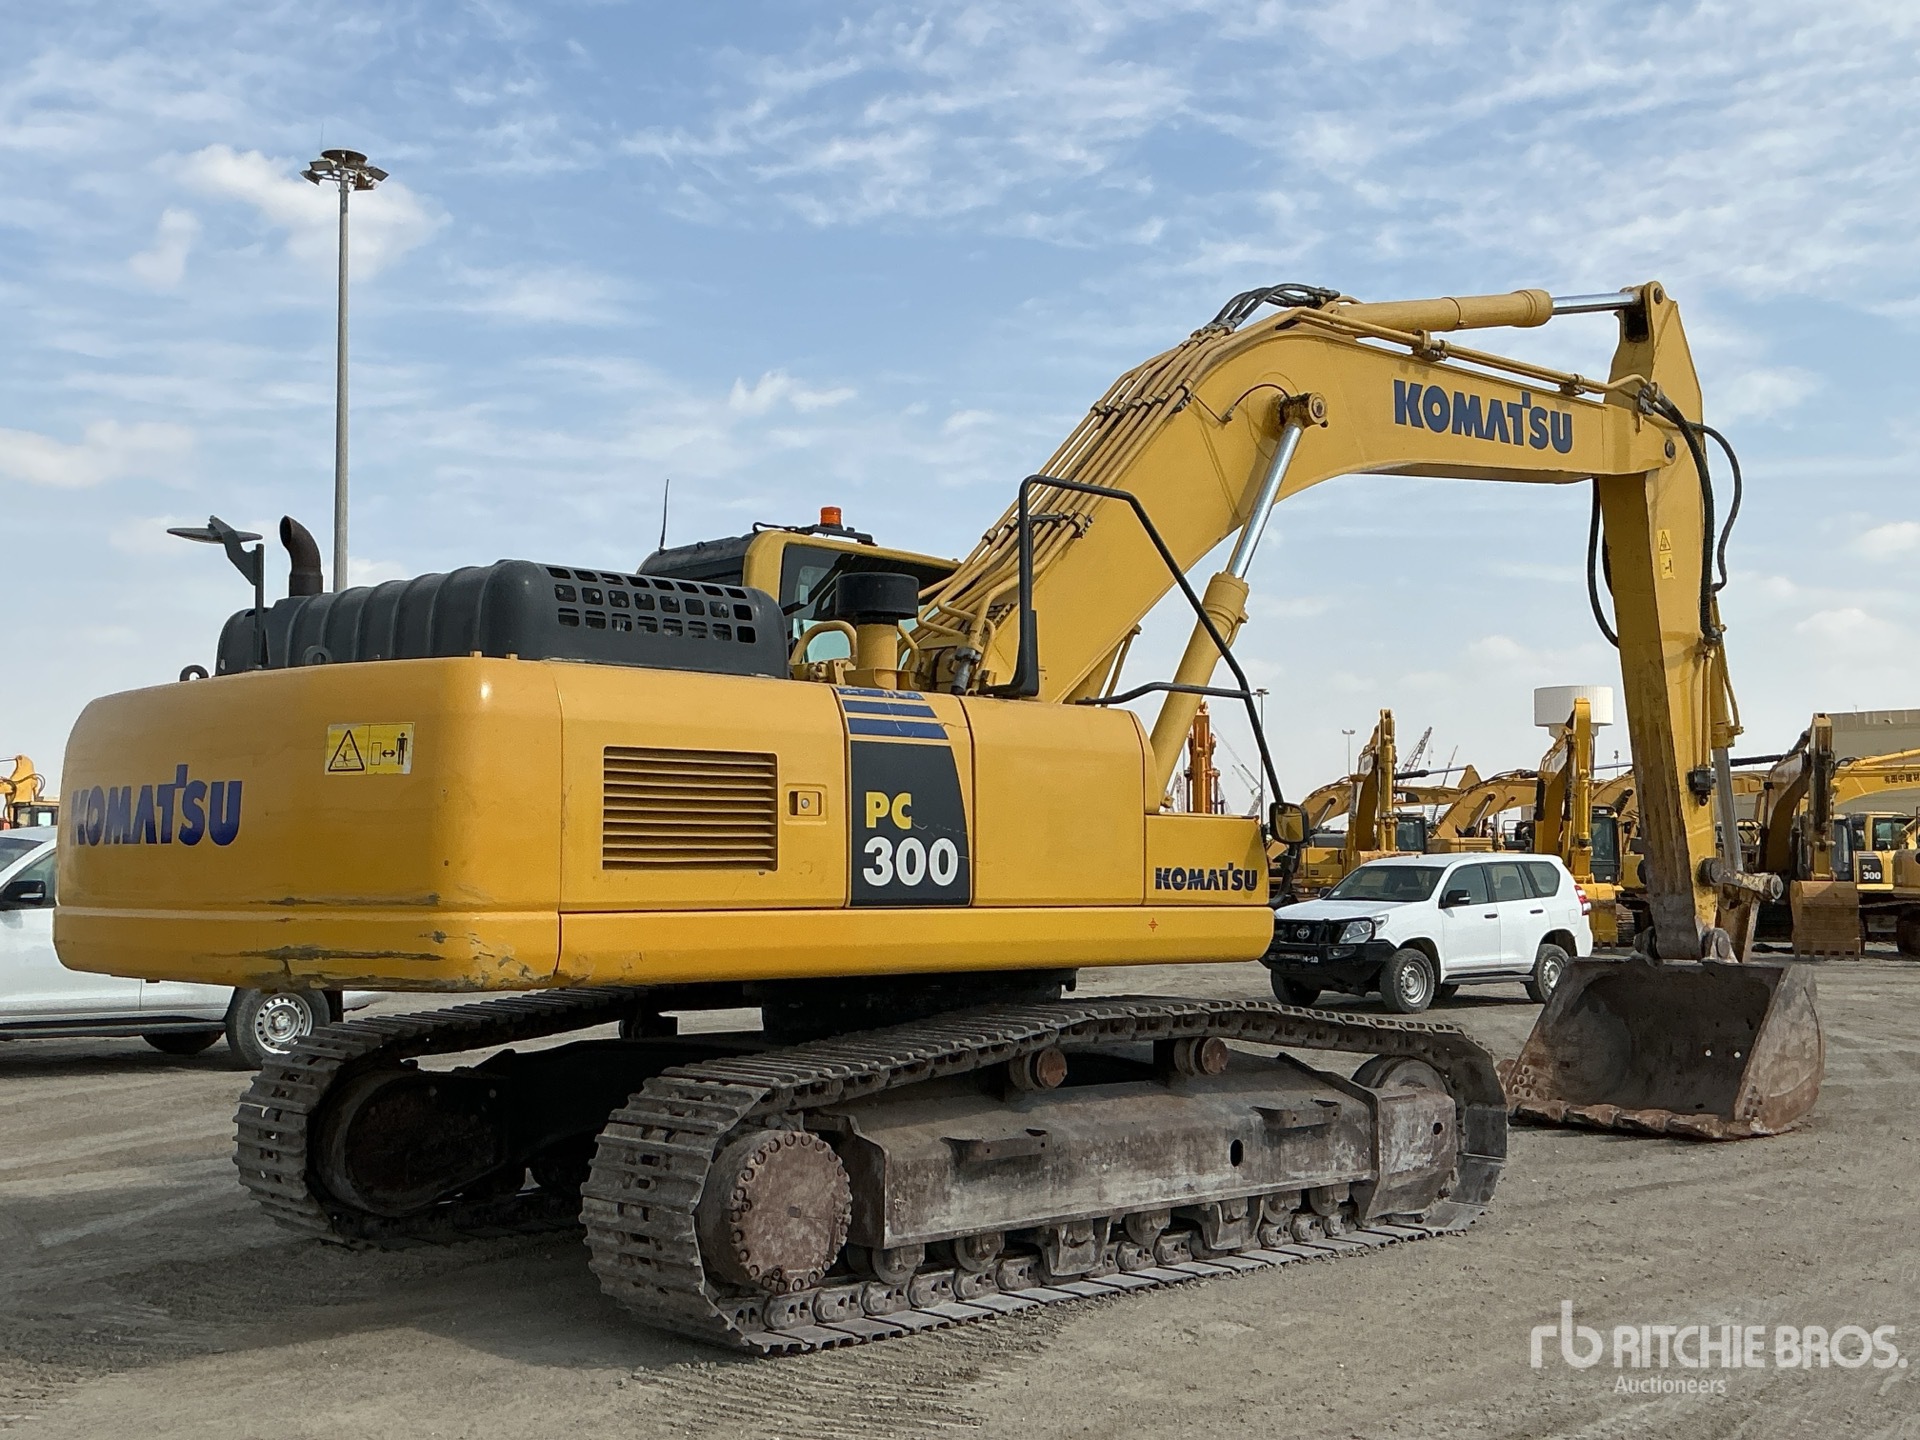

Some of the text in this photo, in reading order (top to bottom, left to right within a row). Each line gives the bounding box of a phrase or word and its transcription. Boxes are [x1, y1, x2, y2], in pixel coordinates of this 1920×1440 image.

[1393, 379, 1573, 454] KOMATSU
[70, 764, 243, 846] KOMATSU
[866, 791, 912, 830] PC
[863, 836, 959, 887] 300
[1155, 862, 1258, 892] KOMATSU
[1863, 871, 1882, 880] 300
